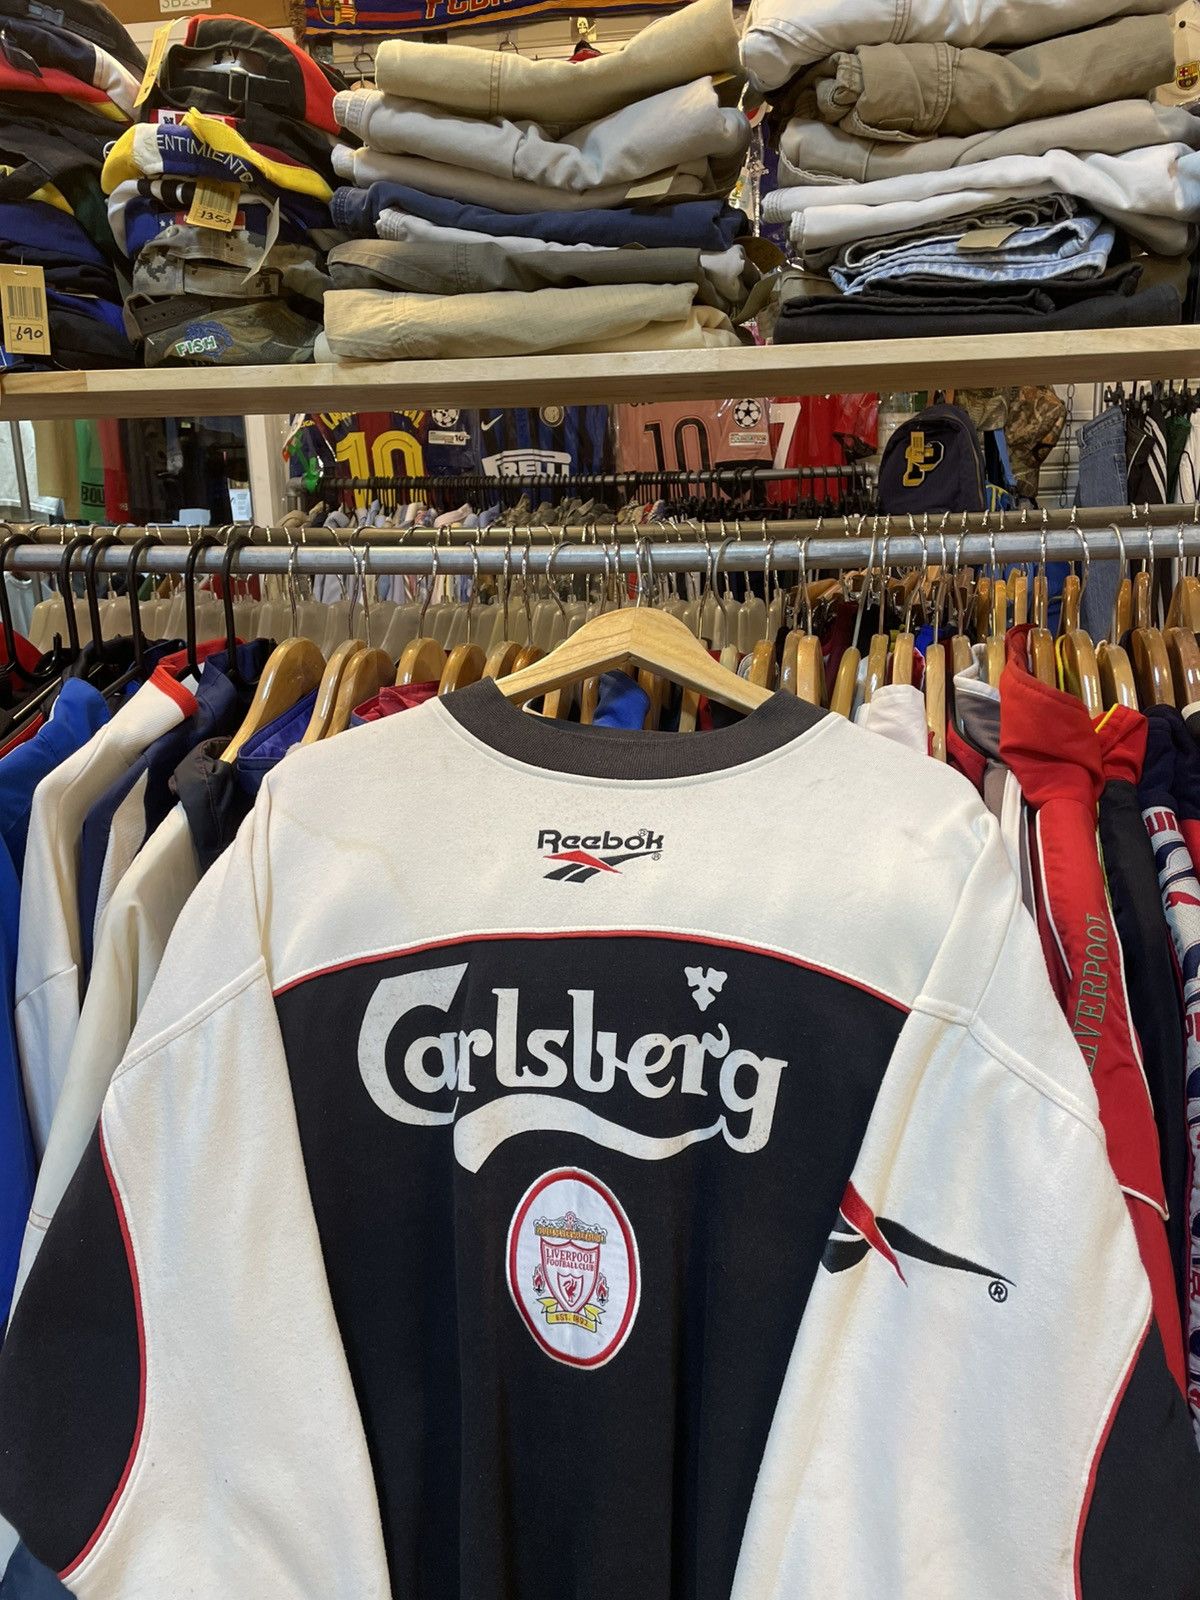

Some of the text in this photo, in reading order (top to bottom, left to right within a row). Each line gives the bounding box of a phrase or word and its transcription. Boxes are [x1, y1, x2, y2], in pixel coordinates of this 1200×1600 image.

[16, 326, 43, 340] 690
[175, 336, 217, 357] FISH
[643, 415, 712, 473] 10
[769, 402, 801, 470] 7
[336, 430, 426, 506] 10
[537, 829, 664, 853] Reebok
[358, 963, 788, 1154] Carlsberg
[546, 1248, 595, 1264] LIVERPOOL
[546, 1258, 594, 1272] FOOTBALL CLUB
